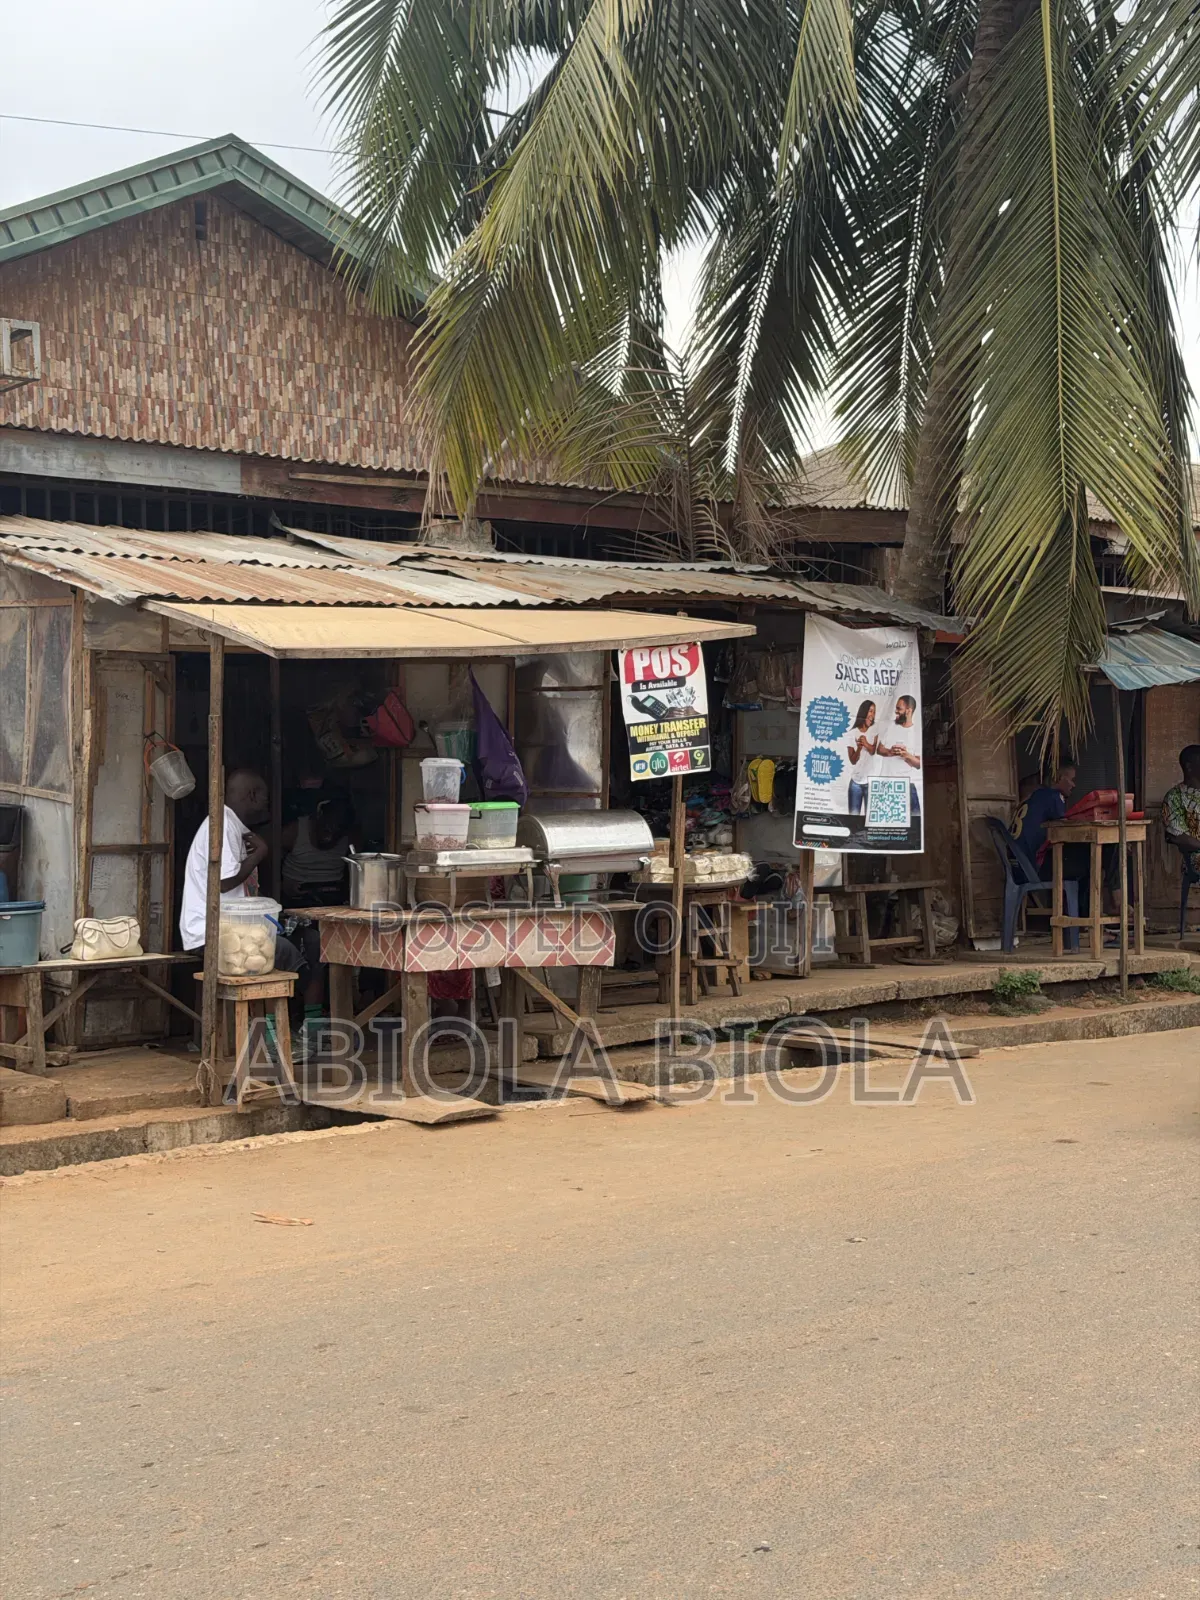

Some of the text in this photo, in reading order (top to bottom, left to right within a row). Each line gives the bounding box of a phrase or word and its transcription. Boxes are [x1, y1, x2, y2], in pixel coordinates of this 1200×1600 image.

[632, 644, 691, 680] POS
[840, 653, 903, 668] JOIN US AS A
[835, 662, 904, 686] SALES AGEN
[648, 680, 678, 689] Available
[837, 682, 861, 694] AND
[863, 686, 887, 696] EARN
[630, 718, 706, 737] MONEY TRANSFER
[676, 729, 700, 738] DEPOSIT
[651, 758, 666, 772] glo
[671, 764, 690, 772] airtel
